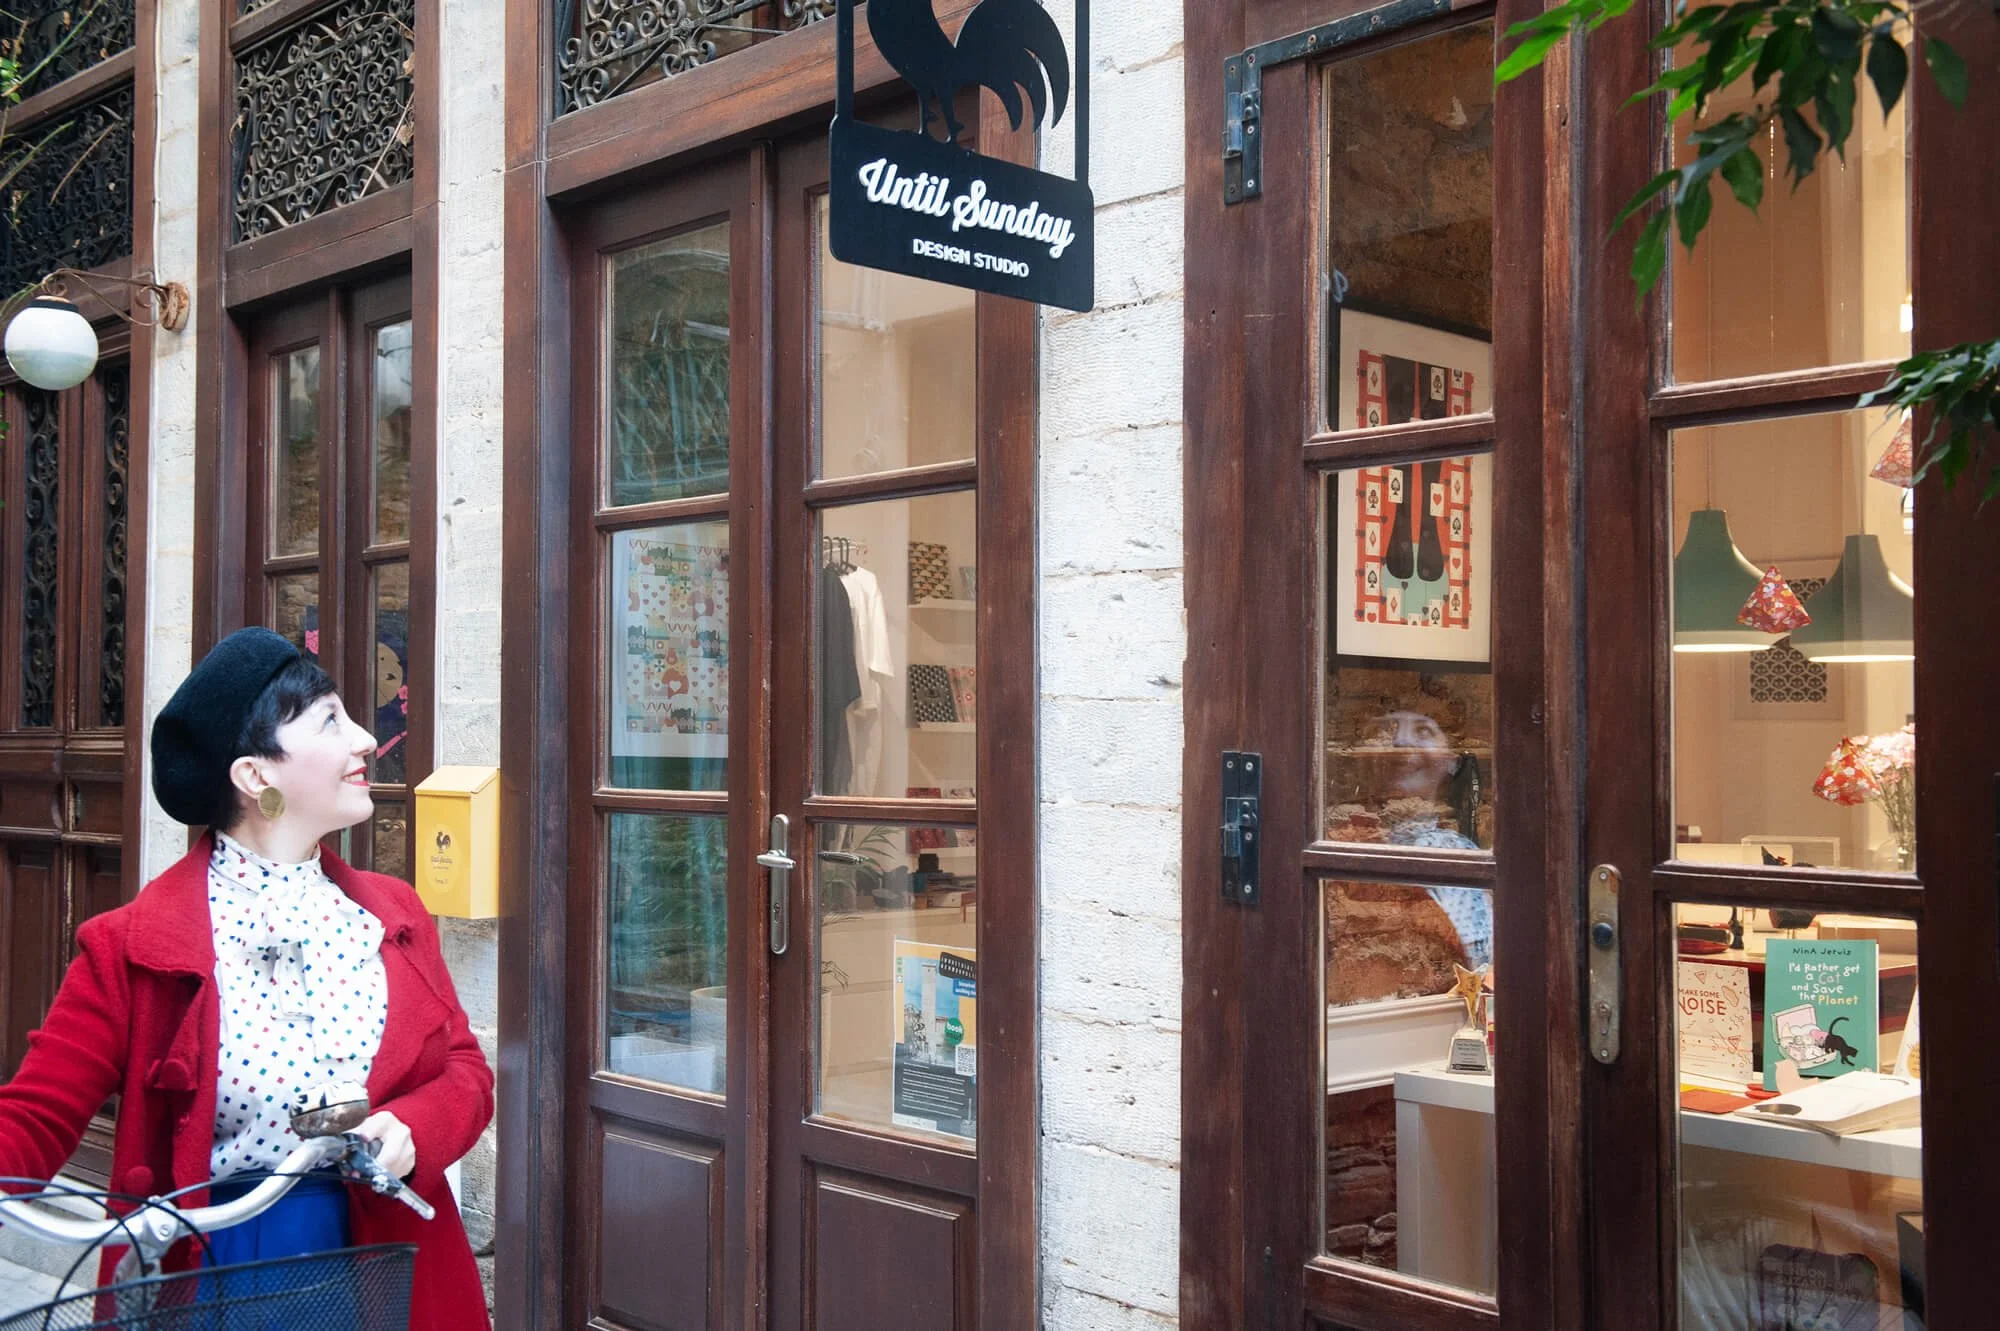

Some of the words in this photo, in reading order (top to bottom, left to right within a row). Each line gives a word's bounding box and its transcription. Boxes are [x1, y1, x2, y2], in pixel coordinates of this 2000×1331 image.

[859, 158, 951, 217] Until
[953, 179, 1075, 259] Sunday
[913, 239, 970, 265] DESIGN
[973, 252, 1029, 278] STUDIO
[1788, 962, 1801, 973] I'd
[1804, 962, 1839, 974] Rather
[1843, 962, 1860, 977] get
[1806, 973, 1814, 981] a
[1818, 972, 1841, 985] Cat
[1700, 990, 1721, 999] SOME
[1791, 983, 1809, 991] and
[1813, 983, 1844, 994] Save
[1800, 992, 1816, 1001] the
[1818, 994, 1859, 1005] Planet
